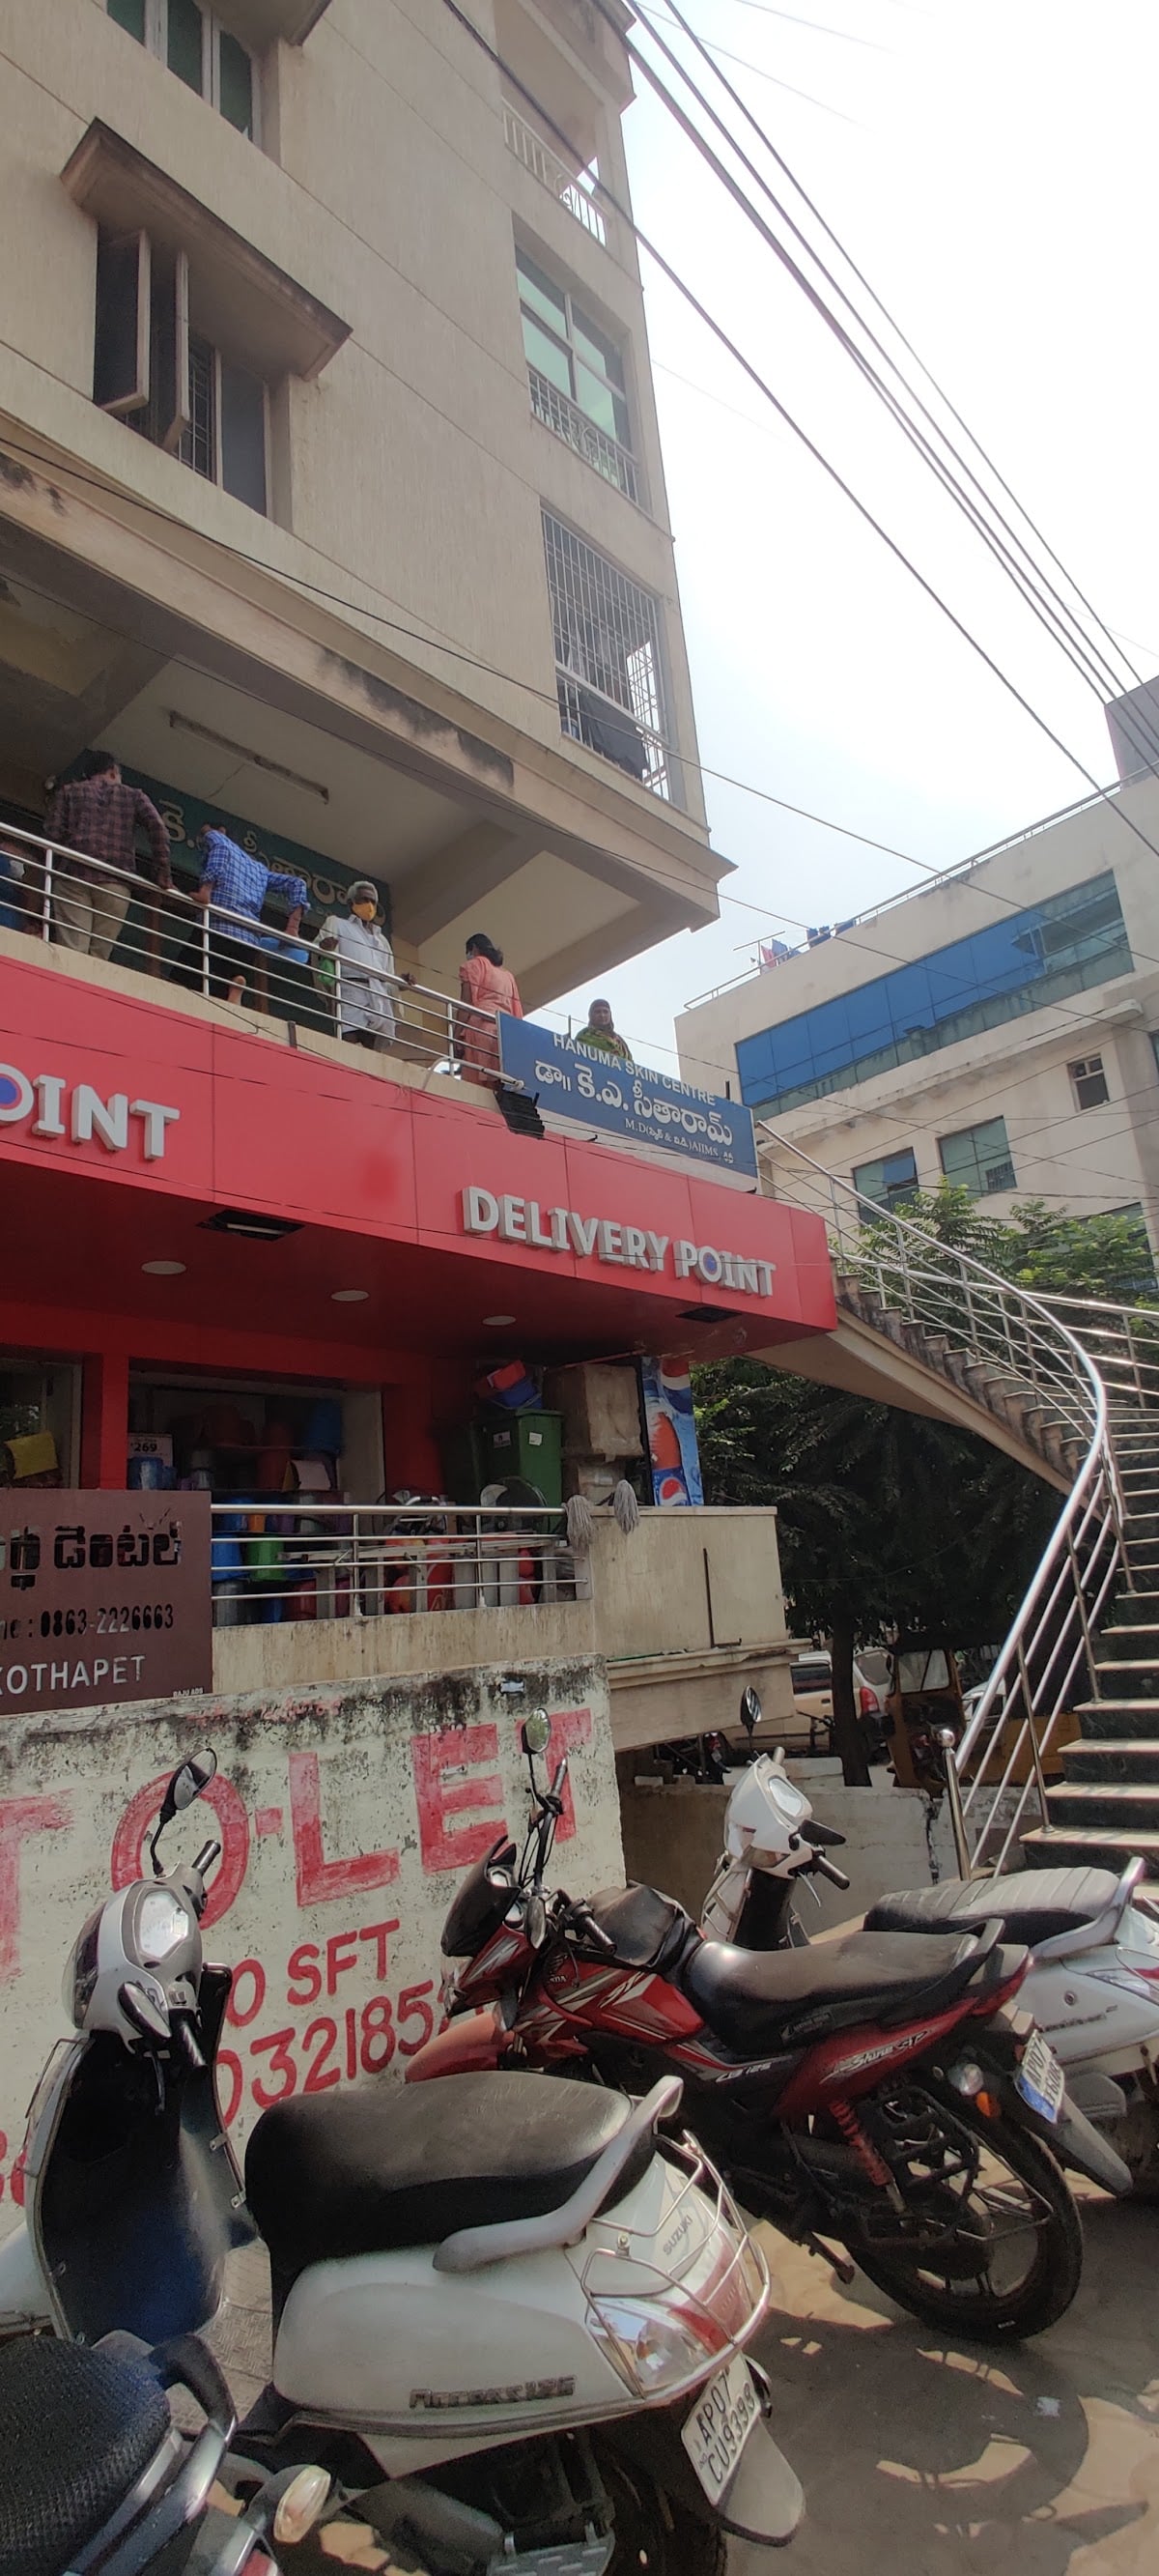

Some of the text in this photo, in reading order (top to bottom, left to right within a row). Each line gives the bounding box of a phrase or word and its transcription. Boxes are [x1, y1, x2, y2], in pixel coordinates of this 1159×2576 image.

[553, 1033, 716, 1106] HANUMA SKIN CENTRE
[462, 1186, 777, 1298] DELIVERY POINT
[0, 1654, 146, 1696] OTHAPET
[287, 1918, 400, 2006] SFT
[663, 2214, 693, 2255] SUZUKI
[695, 2367, 732, 2447] AP07
